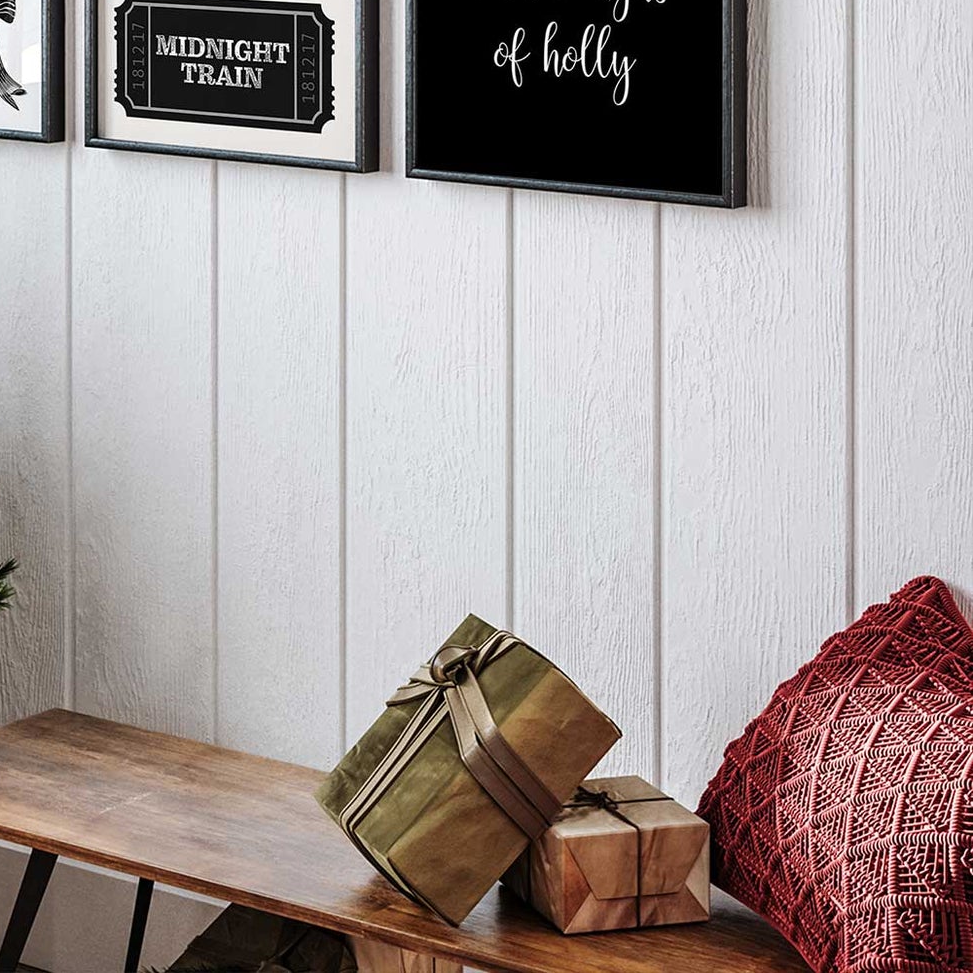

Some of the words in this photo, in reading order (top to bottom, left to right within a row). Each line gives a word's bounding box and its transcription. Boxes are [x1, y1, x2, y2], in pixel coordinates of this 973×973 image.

[132, 23, 145, 89] 181217
[155, 34, 290, 64] MIDNIGHT
[181, 62, 263, 89] TRAIN
[301, 33, 315, 103] 181217
[493, 27, 531, 87] of
[543, 21, 637, 106] holly
